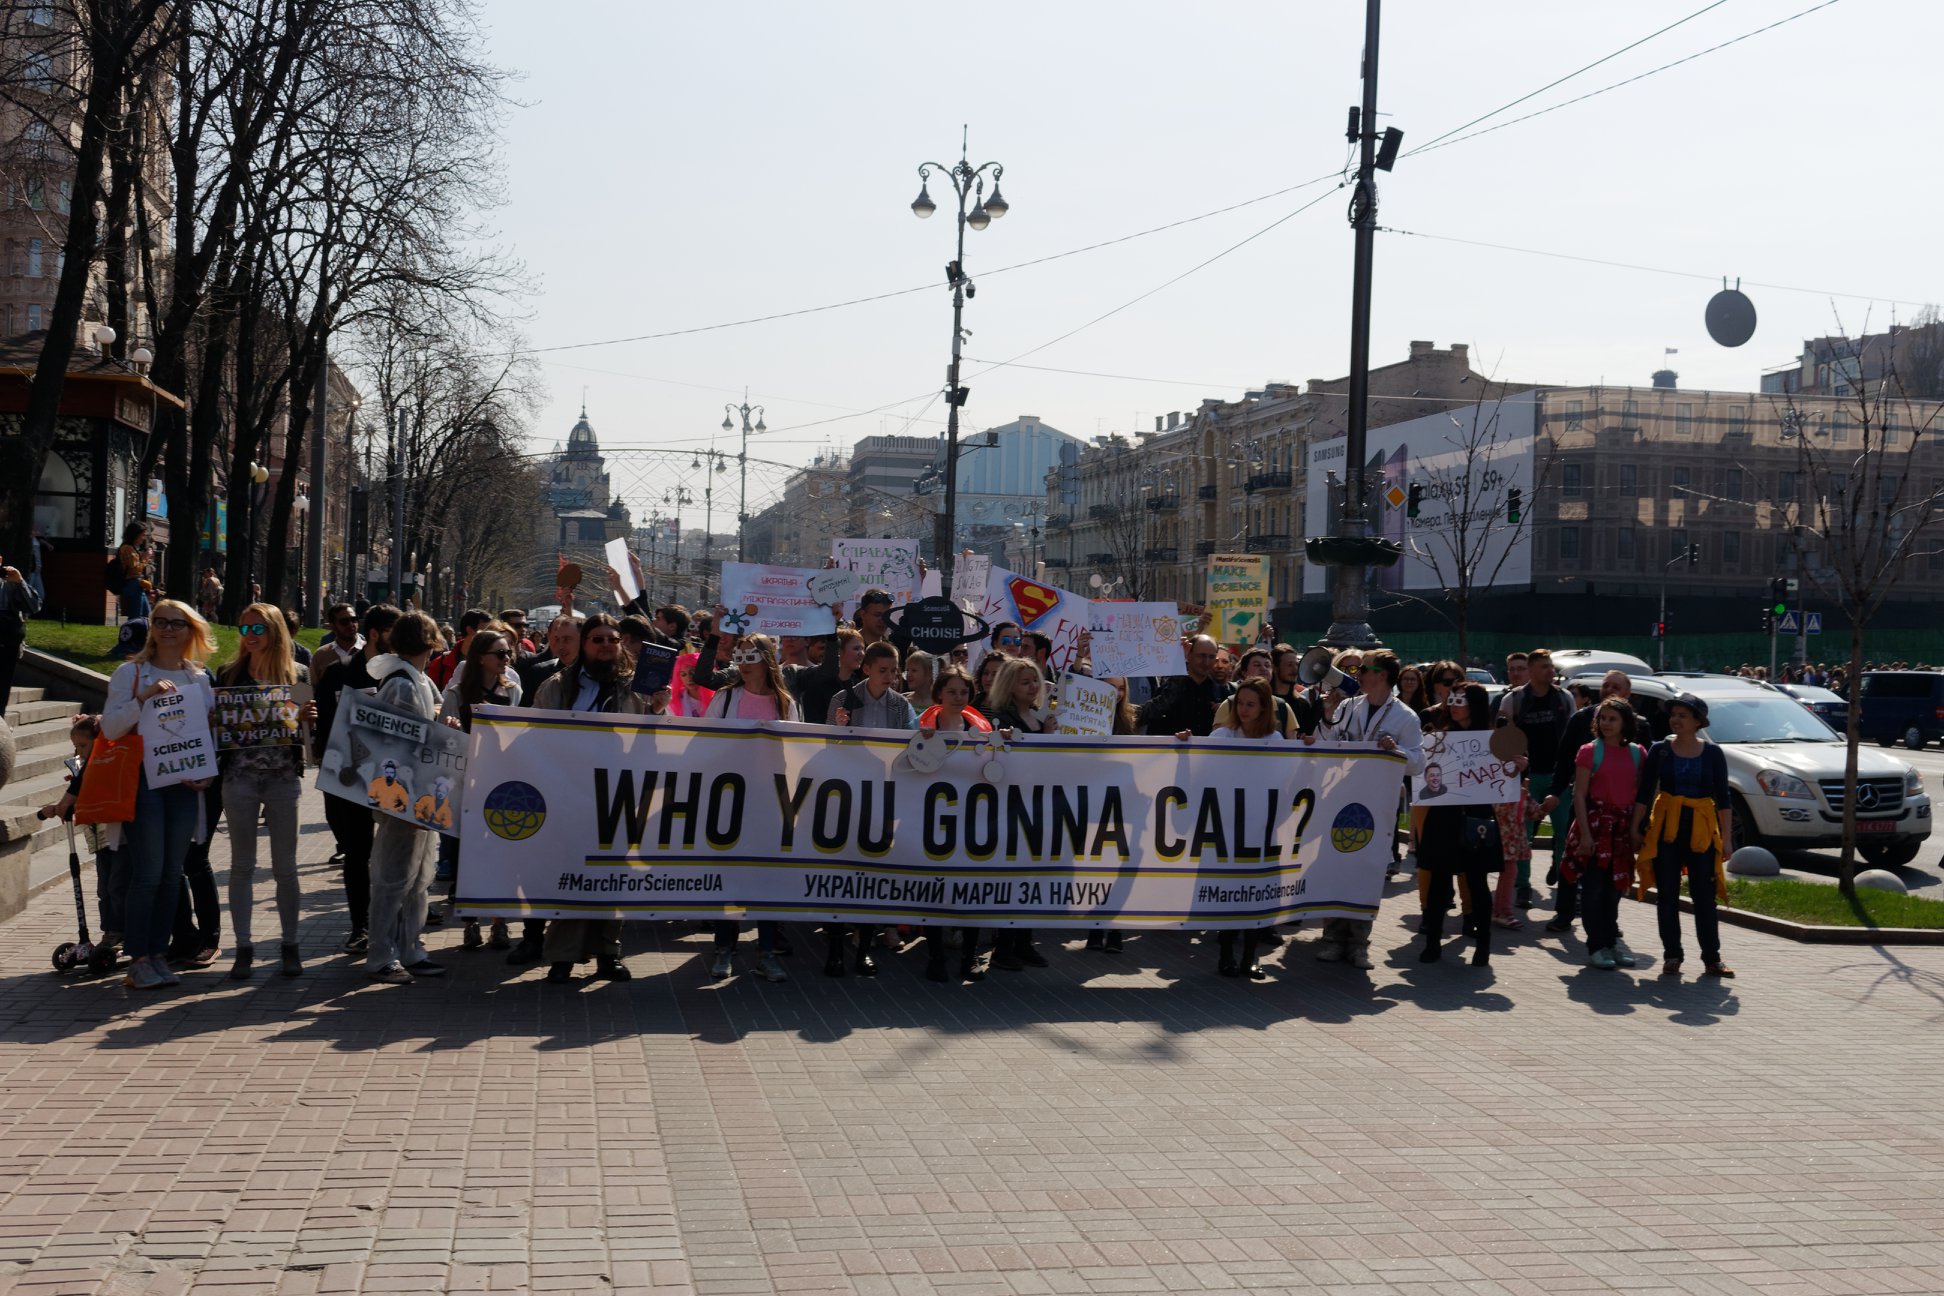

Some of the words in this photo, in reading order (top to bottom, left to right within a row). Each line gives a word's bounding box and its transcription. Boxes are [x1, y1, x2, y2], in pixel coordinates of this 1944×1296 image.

[1313, 445, 1345, 463] SAMSUNG
[1213, 565, 1247, 577] MAKE
[1213, 582, 1261, 592] SCIENCE
[1210, 599, 1234, 609] NOT
[1238, 597, 1263, 608] WAR
[911, 627, 961, 639] CHOISE
[153, 694, 184, 709] KEEP
[218, 691, 292, 705] ПІДТРИМА
[157, 709, 185, 723] OUR
[222, 706, 300, 725] НАУКУ
[355, 708, 422, 738] SCIENCE
[221, 731, 232, 742] В
[153, 738, 203, 757] SCIENCE
[156, 753, 207, 776] ALIVE
[421, 748, 468, 773] BITC
[594, 768, 747, 852] WHO
[774, 773, 896, 858] YOU
[922, 781, 1131, 863] GONNA
[1153, 786, 1316, 863] CALL?
[557, 873, 723, 893] #MarchForScienceUA
[804, 871, 946, 905] УКРАЇНСЬКИЙ
[951, 880, 1012, 904] МАРШ
[1018, 881, 1043, 904] ЗА
[1050, 882, 1113, 905] НАУКУ
[1198, 879, 1307, 904] #MarchForScienceUA
